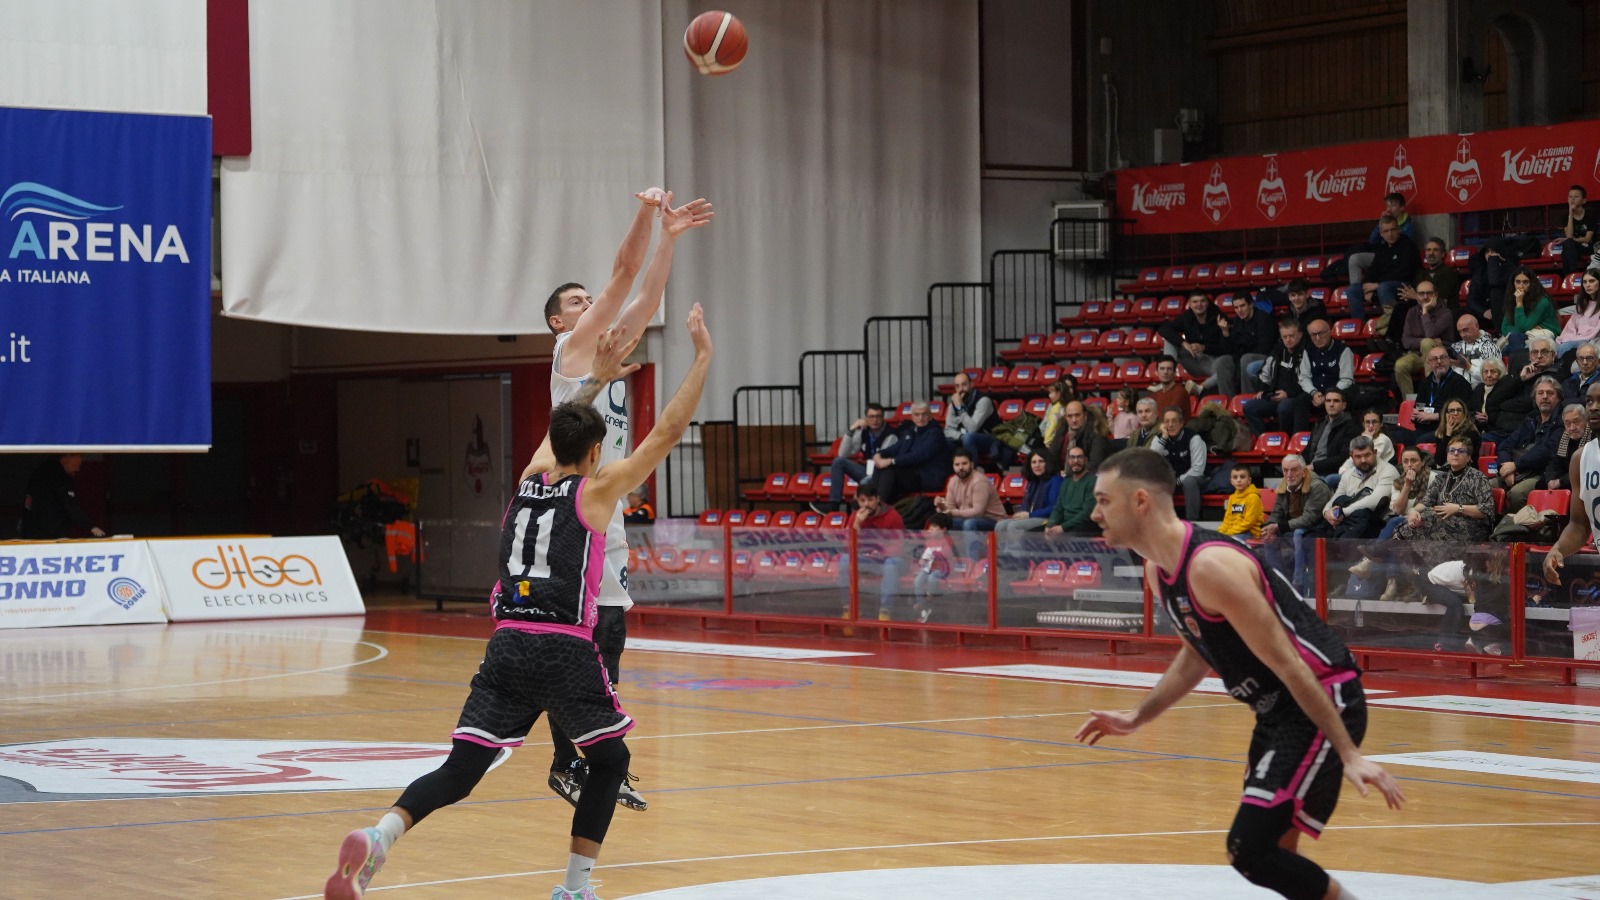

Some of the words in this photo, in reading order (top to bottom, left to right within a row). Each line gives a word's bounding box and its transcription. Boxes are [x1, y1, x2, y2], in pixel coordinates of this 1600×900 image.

[9, 220, 190, 264] ARENA
[17, 269, 91, 284] ITALIANA
[507, 507, 556, 579] 11
[0, 554, 125, 576] BASKET
[192, 544, 322, 590] diba
[122, 588, 147, 611] ROBUR
[203, 591, 328, 608] ELECTRONICS
[1255, 750, 1276, 779] 4
